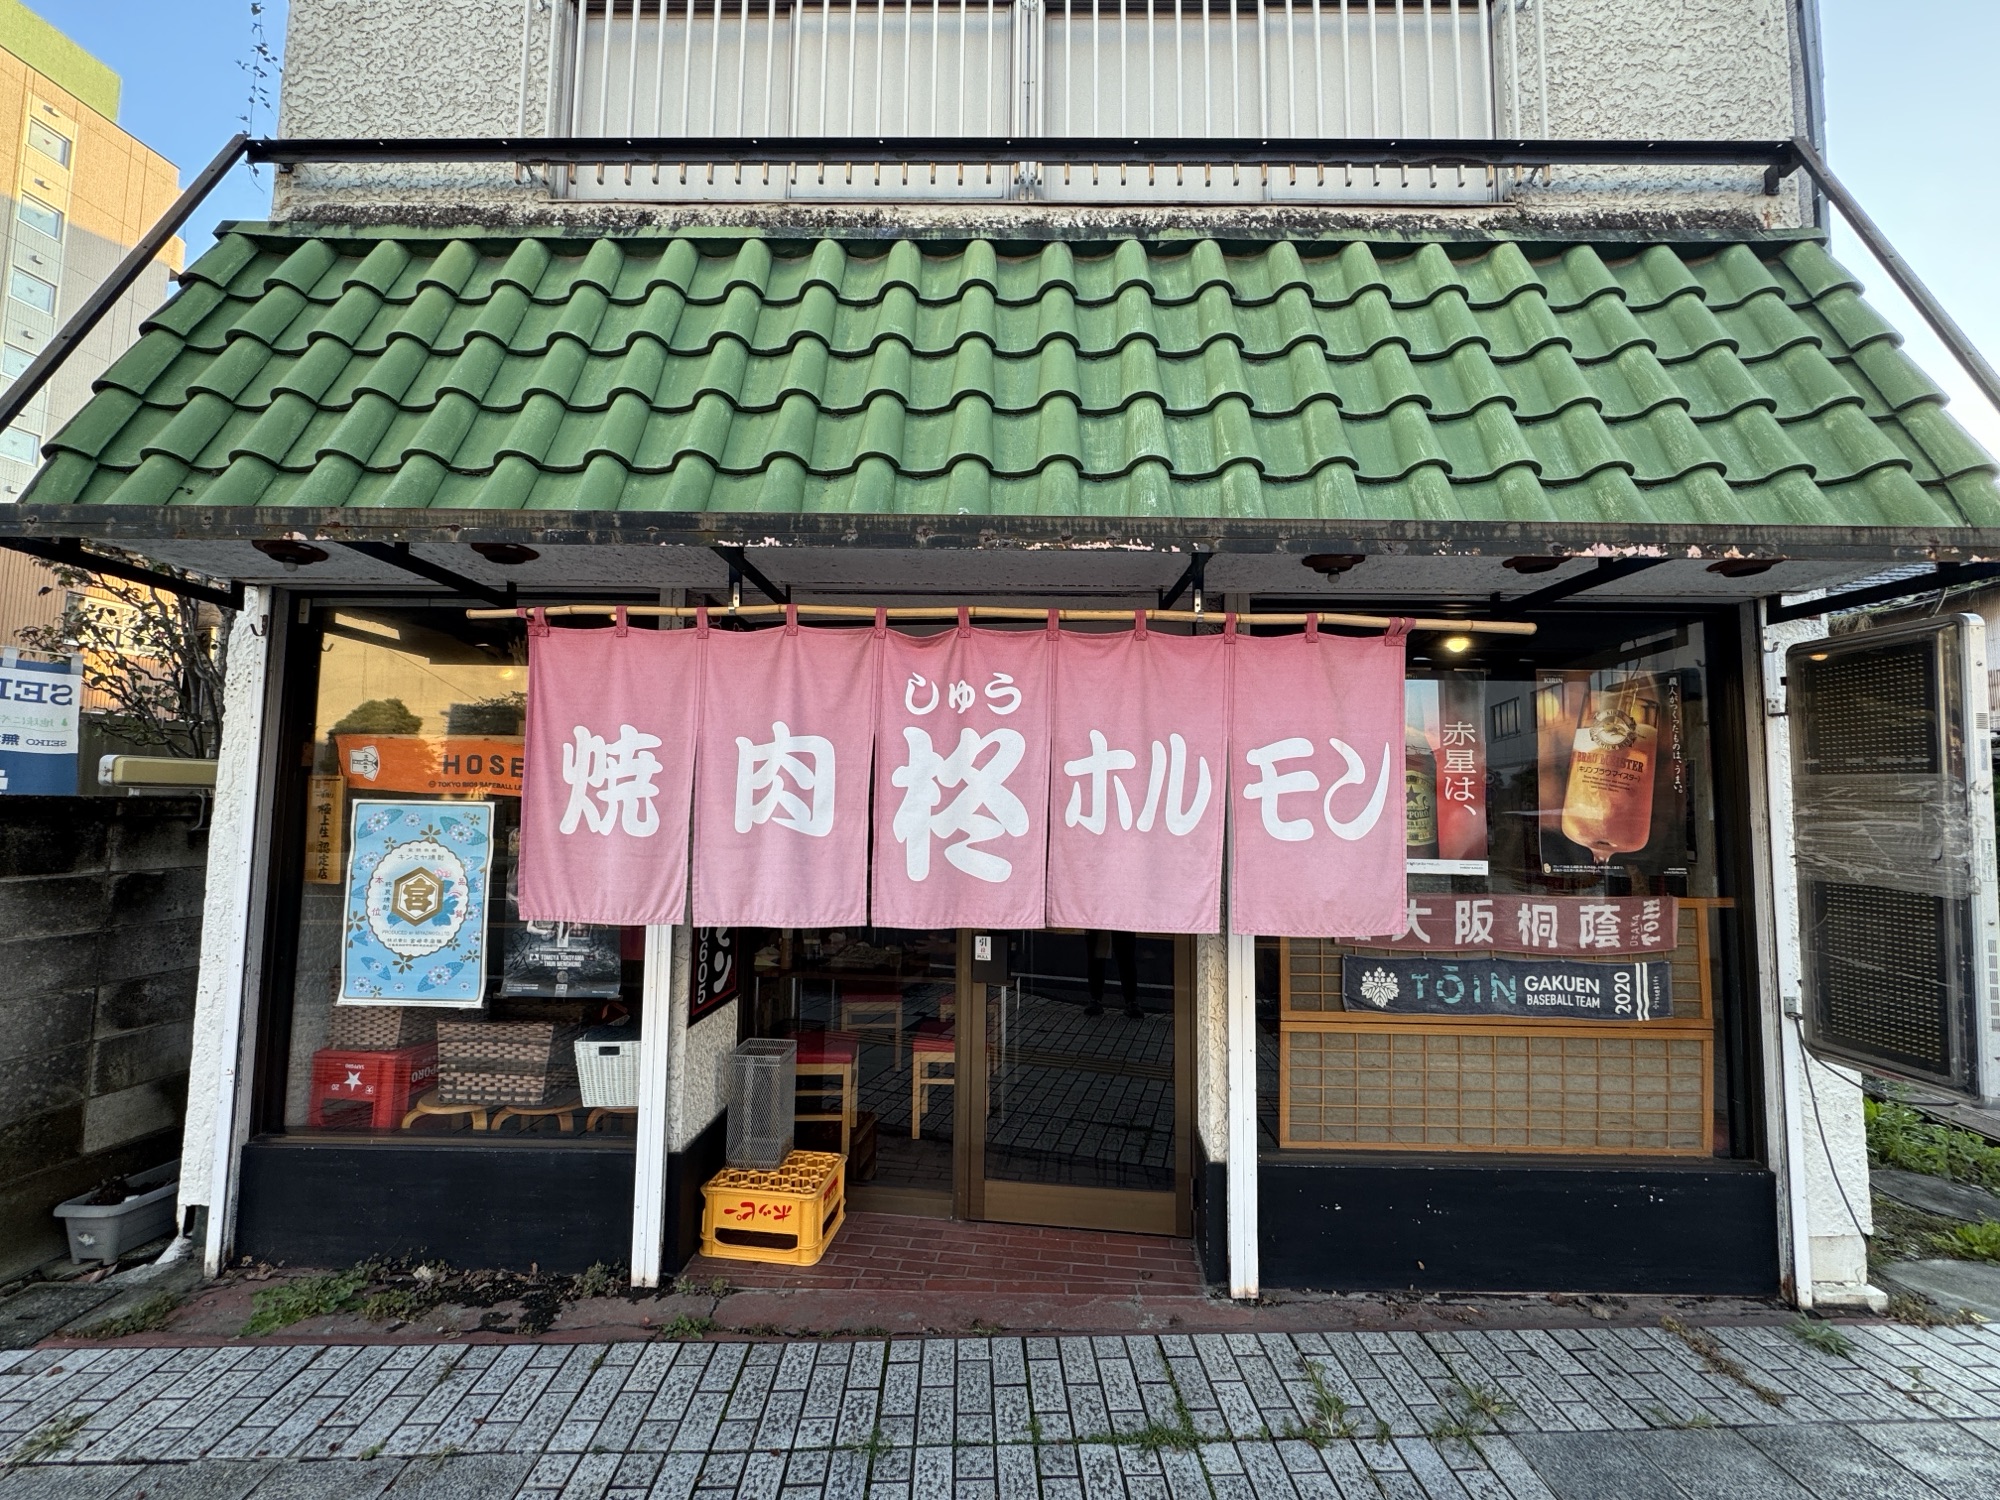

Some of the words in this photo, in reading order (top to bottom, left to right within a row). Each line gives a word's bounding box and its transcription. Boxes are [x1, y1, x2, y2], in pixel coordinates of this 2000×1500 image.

[905, 673, 1021, 714] しゅう
[443, 755, 524, 777] HOSE
[1443, 721, 1477, 816] 赤星は、
[318, 841, 331, 880] 認定店
[979, 937, 987, 947] 引
[1524, 975, 1600, 995] GAKUEN
[1613, 971, 1632, 1015] 2020
[1526, 993, 1575, 1007] BASEBALL
[1575, 994, 1600, 1009] TEAM
[724, 1202, 792, 1222] ホッピー
